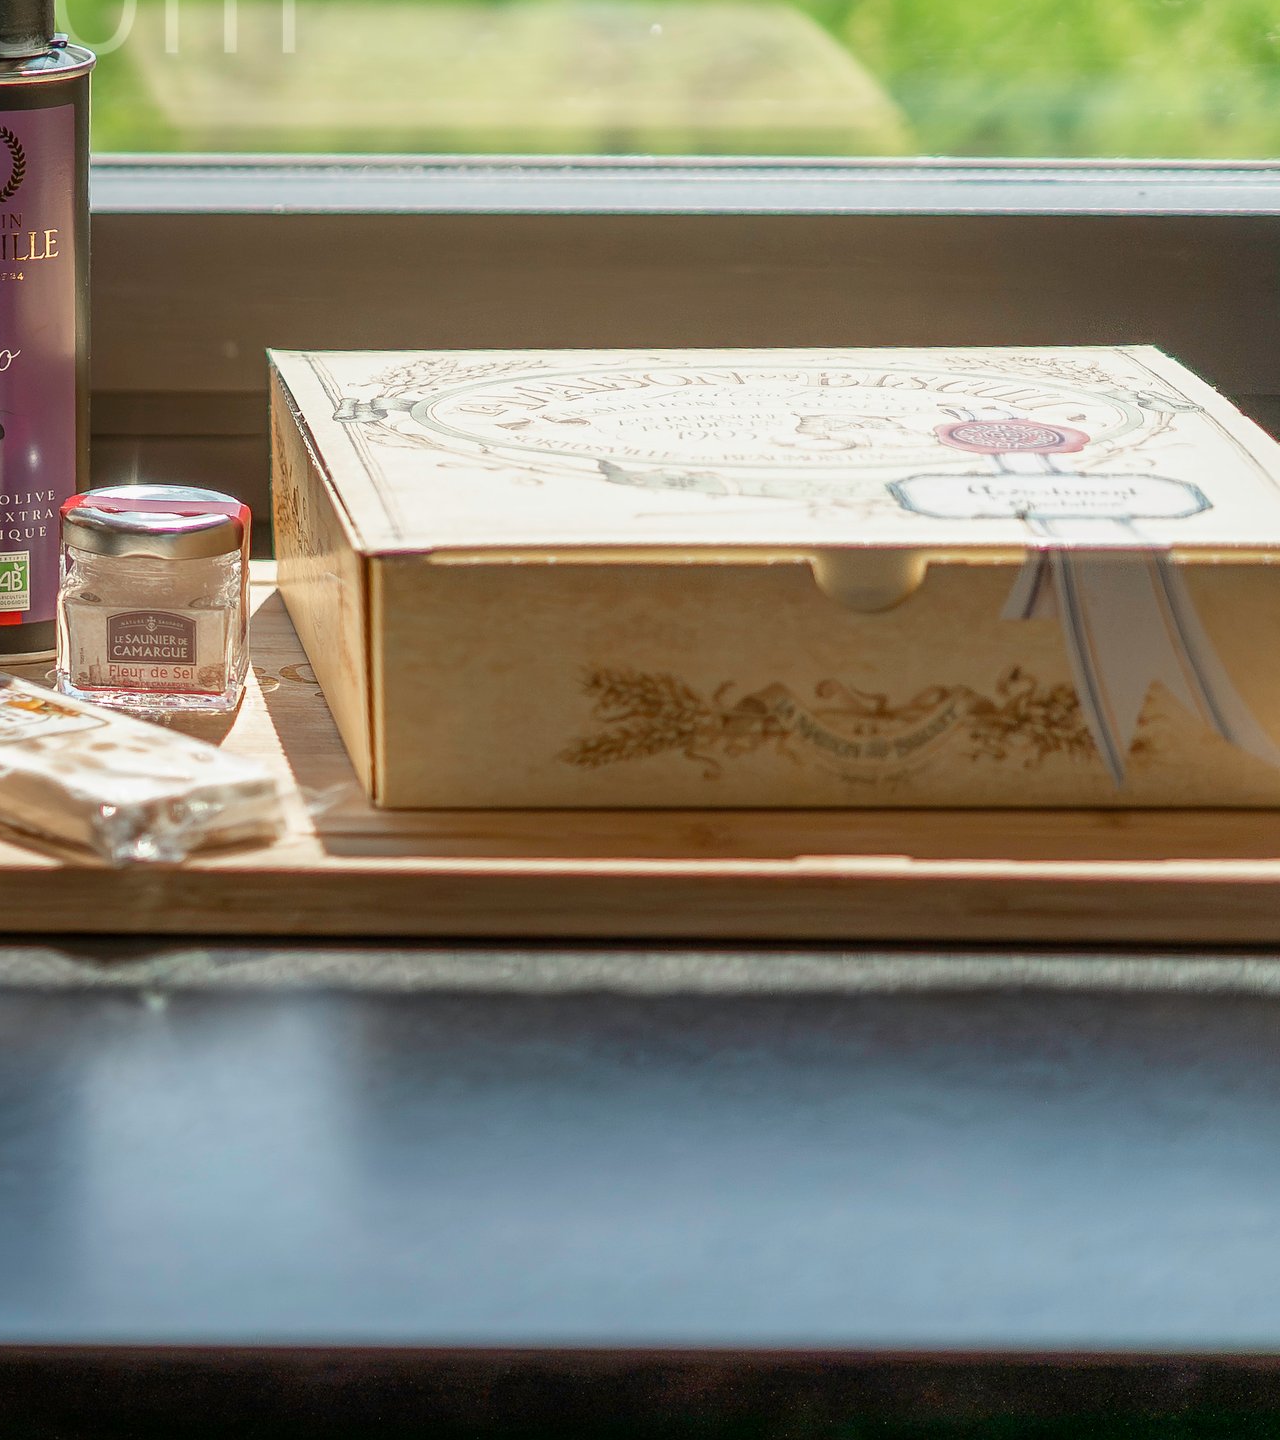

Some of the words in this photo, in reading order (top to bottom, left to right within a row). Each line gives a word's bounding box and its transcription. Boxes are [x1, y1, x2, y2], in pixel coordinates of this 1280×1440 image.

[114, 635, 124, 643] LE
[125, 633, 176, 646] SAUNIER
[178, 638, 188, 646] DE
[113, 645, 188, 658] CAMARGUE
[108, 664, 145, 678] Fleur
[150, 666, 168, 678] de
[173, 666, 194, 679] Sel
